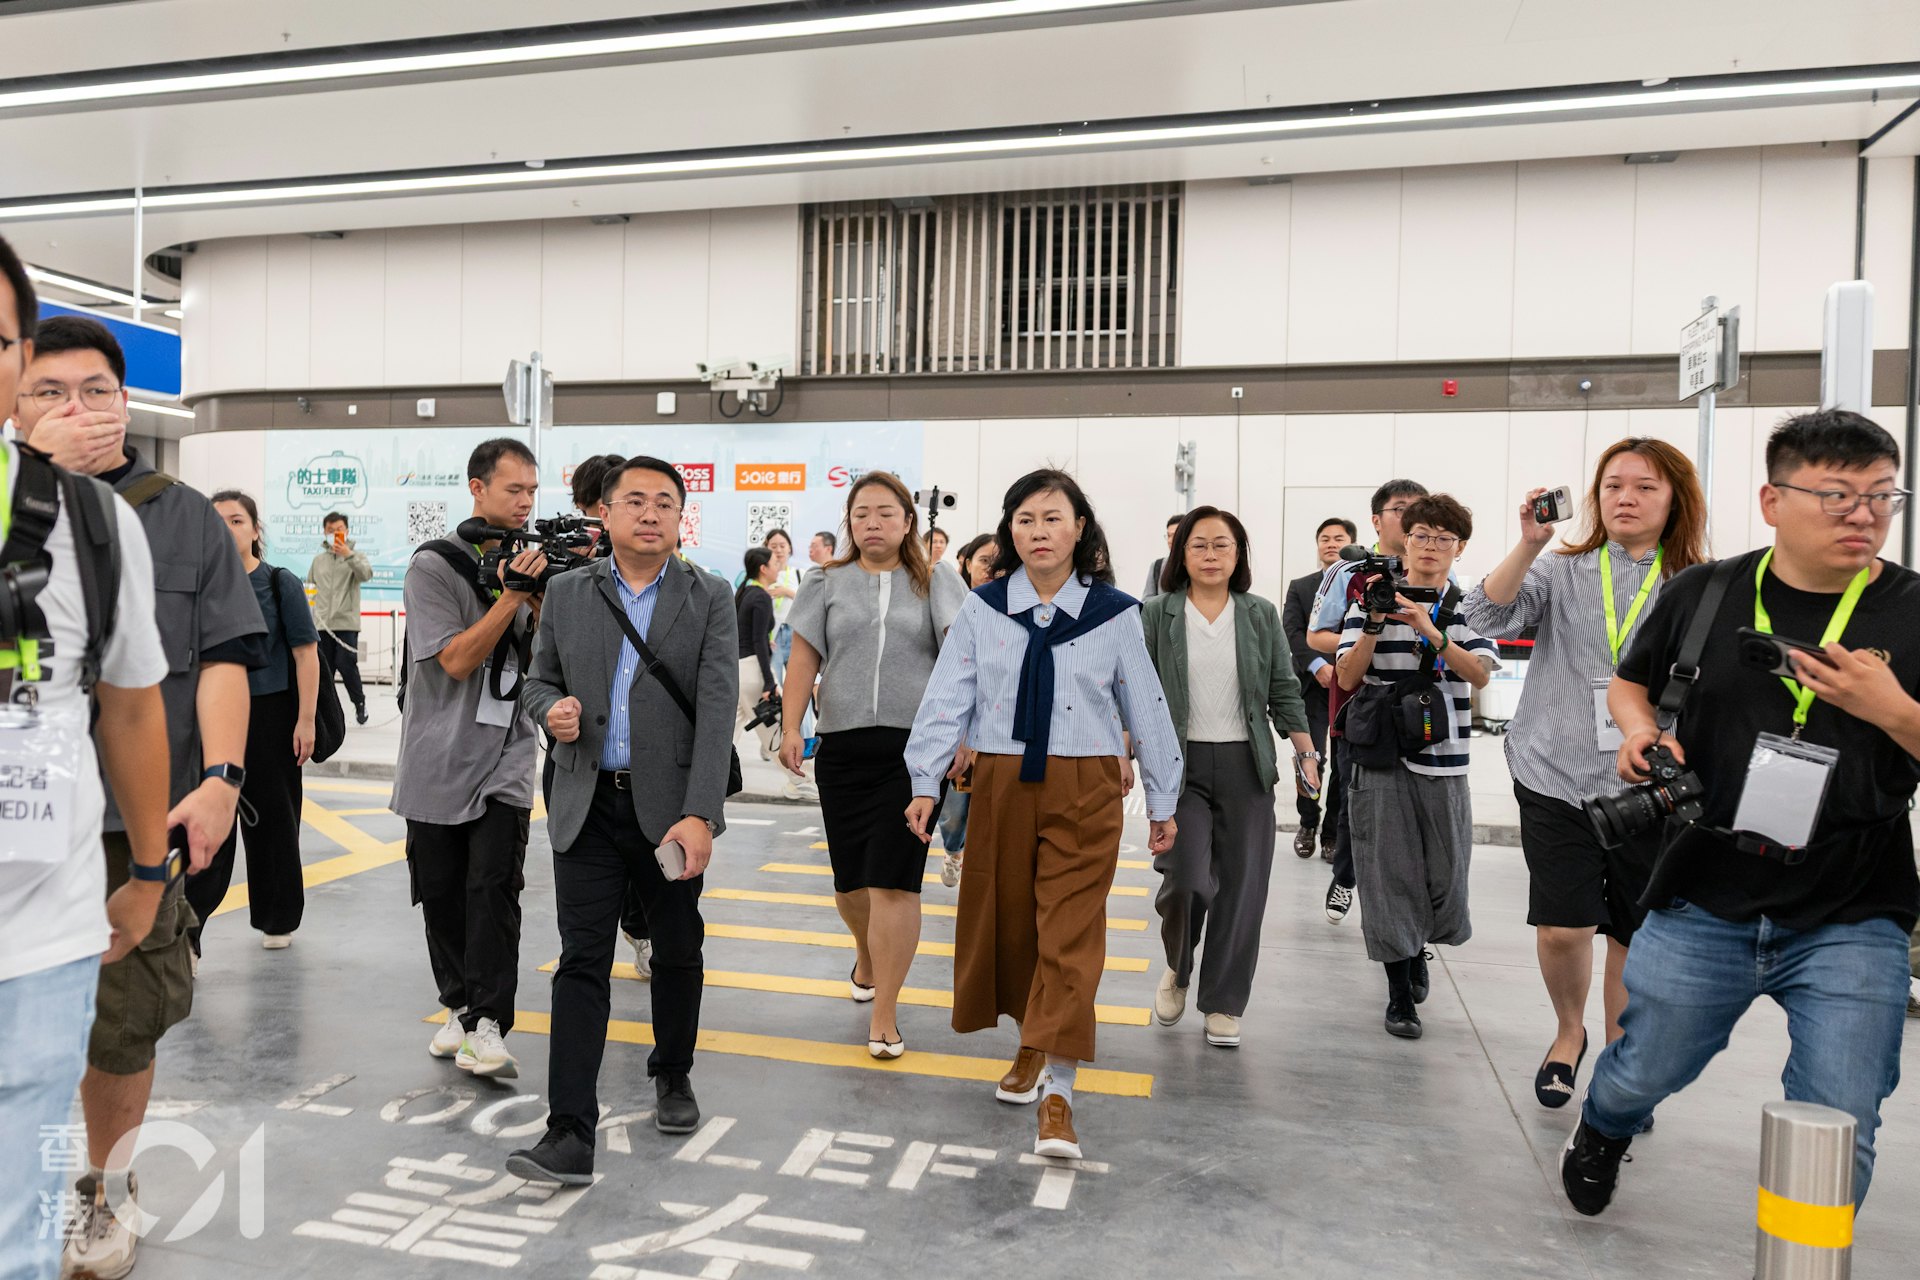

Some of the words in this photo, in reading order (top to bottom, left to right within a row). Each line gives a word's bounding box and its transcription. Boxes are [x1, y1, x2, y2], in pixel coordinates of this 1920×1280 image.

[297, 468, 357, 485] 的士車隊
[302, 486, 322, 496] TAXI
[324, 486, 352, 496] FLEET
[0, 800, 54, 821] EDIA
[672, 1115, 1110, 1211] LEFT
